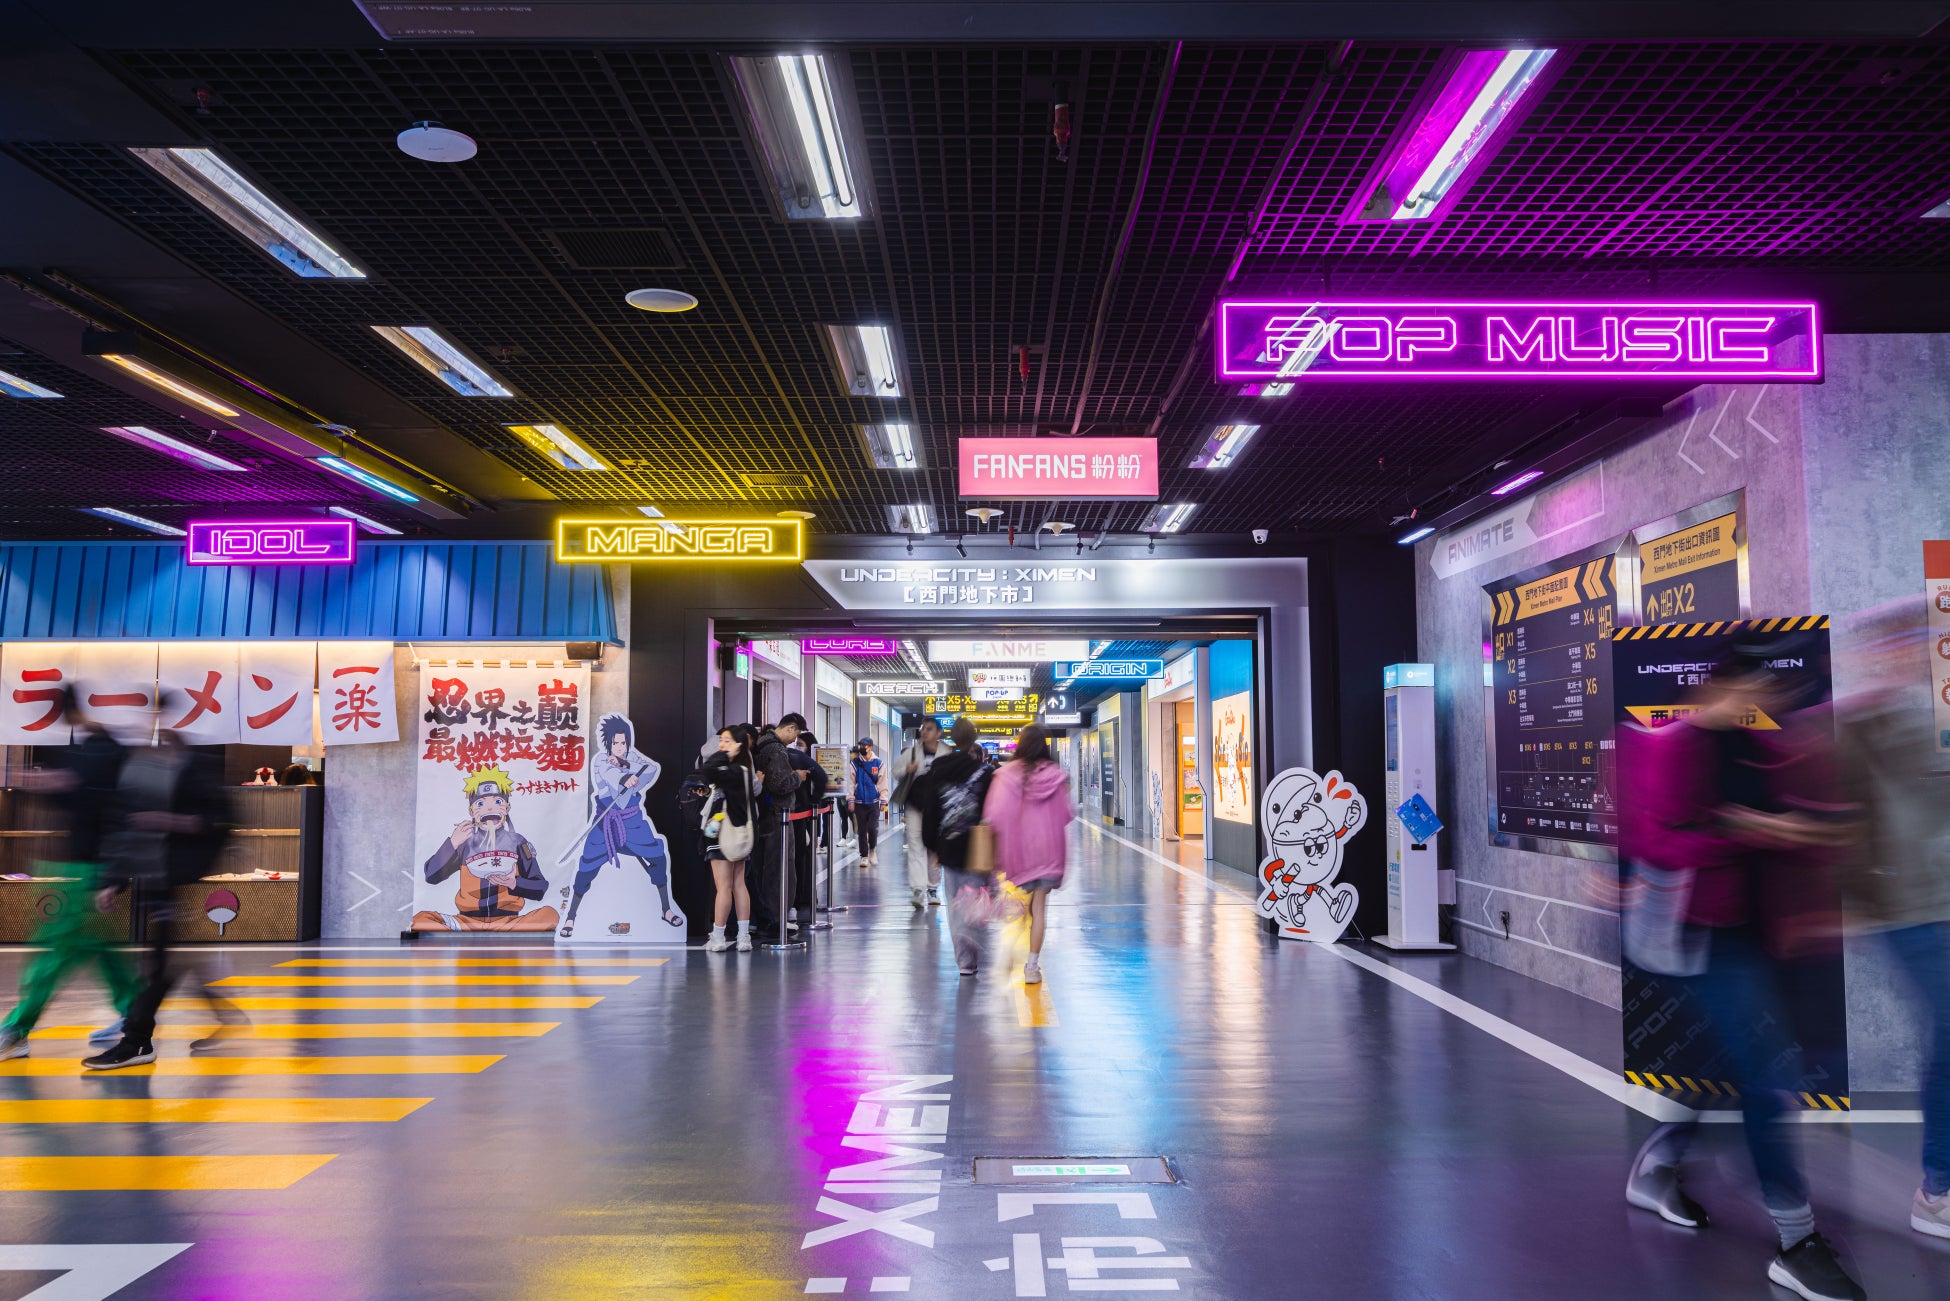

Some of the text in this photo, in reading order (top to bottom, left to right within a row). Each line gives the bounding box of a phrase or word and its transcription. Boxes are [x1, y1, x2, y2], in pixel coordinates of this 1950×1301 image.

[1264, 316, 1776, 363] POP MUSIC
[973, 454, 1086, 479] FANFANS
[211, 530, 331, 555] IDOL
[588, 527, 773, 553] MANGA
[1448, 517, 1514, 565] ANIMATE
[841, 568, 996, 582] UNDERCITY
[1015, 568, 1096, 582] XIMEN
[1674, 582, 1695, 616] X2
[1583, 606, 1595, 626] X4
[1506, 631, 1514, 647] X1
[972, 642, 1047, 657] FANME
[1584, 642, 1596, 661] X5
[1071, 663, 1147, 676] ORIGIN
[1507, 658, 1516, 675] X2
[866, 683, 939, 694] MERCH
[1585, 677, 1598, 695] X6
[12, 668, 300, 732] ラーメン
[332, 666, 381, 732] 一楽
[1508, 689, 1517, 705] X3
[800, 1074, 954, 1250] XIMEN
